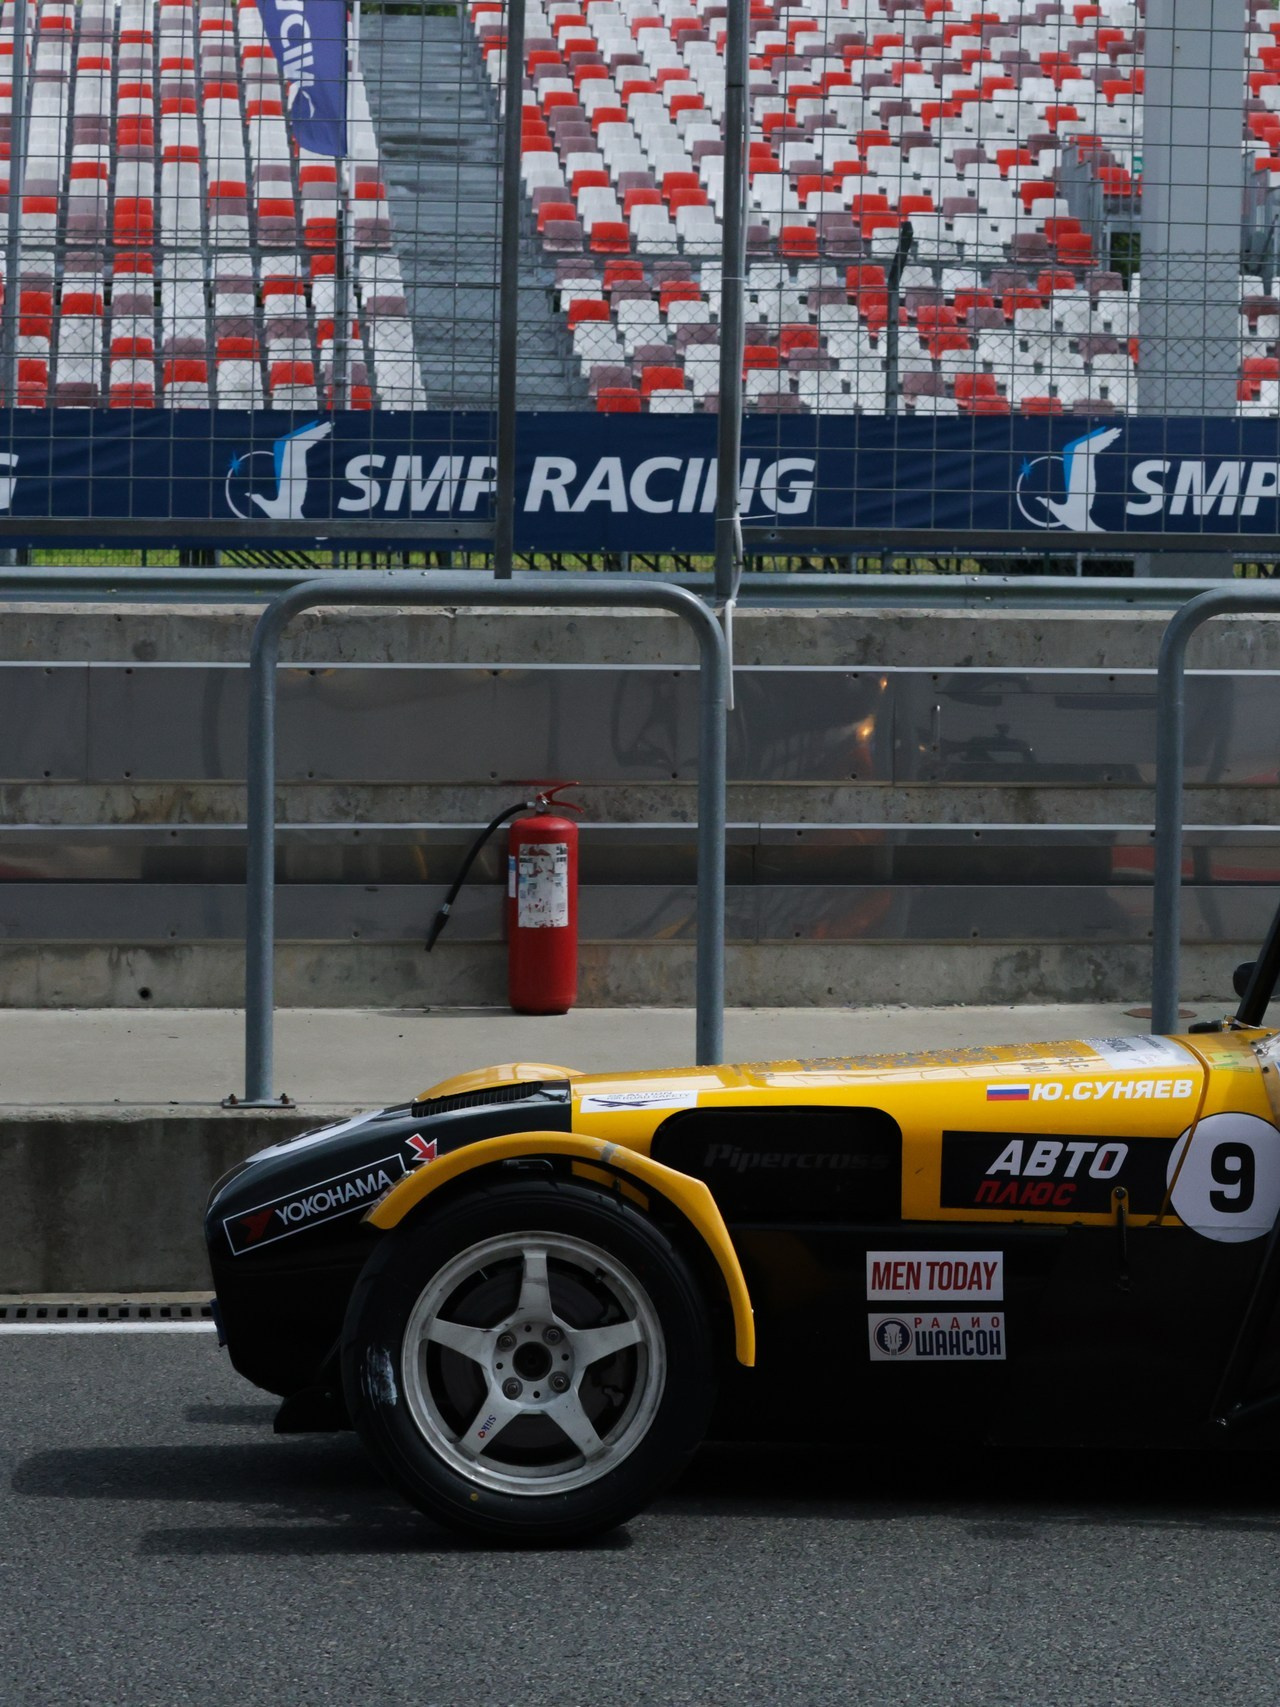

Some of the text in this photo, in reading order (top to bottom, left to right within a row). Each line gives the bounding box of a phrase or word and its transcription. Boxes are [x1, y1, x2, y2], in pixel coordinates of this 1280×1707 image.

[337, 454, 816, 514] SMP RACING
[1031, 1079, 1194, 1101] Ю.СУНЯЕВ
[703, 1143, 892, 1174] Pipercross
[985, 1139, 1129, 1179] АВТО
[1209, 1141, 1255, 1213] 9
[275, 1169, 395, 1226] YOKOHAMA
[974, 1181, 1077, 1206] ПЛЮС
[871, 1261, 998, 1291] MEN TODAY
[914, 1316, 1000, 1330] РАДИО
[915, 1330, 1002, 1356] ШАНСОН
